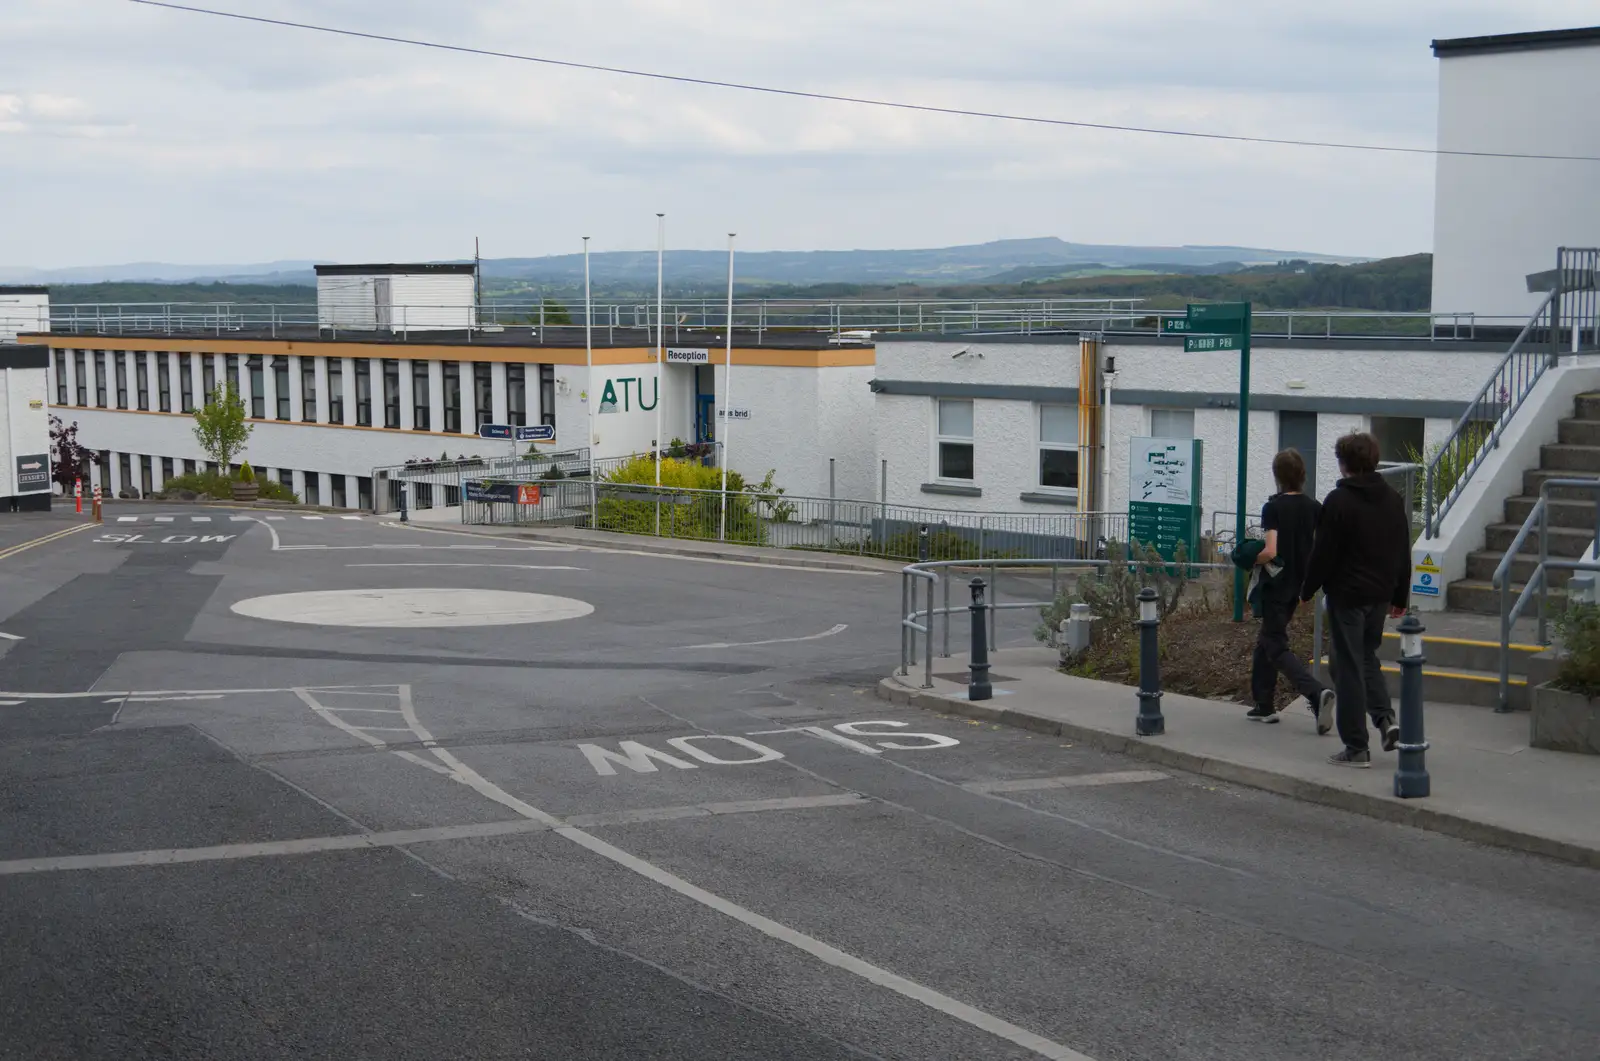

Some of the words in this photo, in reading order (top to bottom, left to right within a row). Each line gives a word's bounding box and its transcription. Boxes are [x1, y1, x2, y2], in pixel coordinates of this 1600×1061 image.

[1167, 320, 1174, 329] P
[1188, 339, 1194, 349] P
[1219, 338, 1225, 348] P
[667, 350, 707, 362] Reception
[598, 376, 659, 414] ATU
[93, 534, 236, 543] SLOW
[577, 721, 960, 776] SLOW
